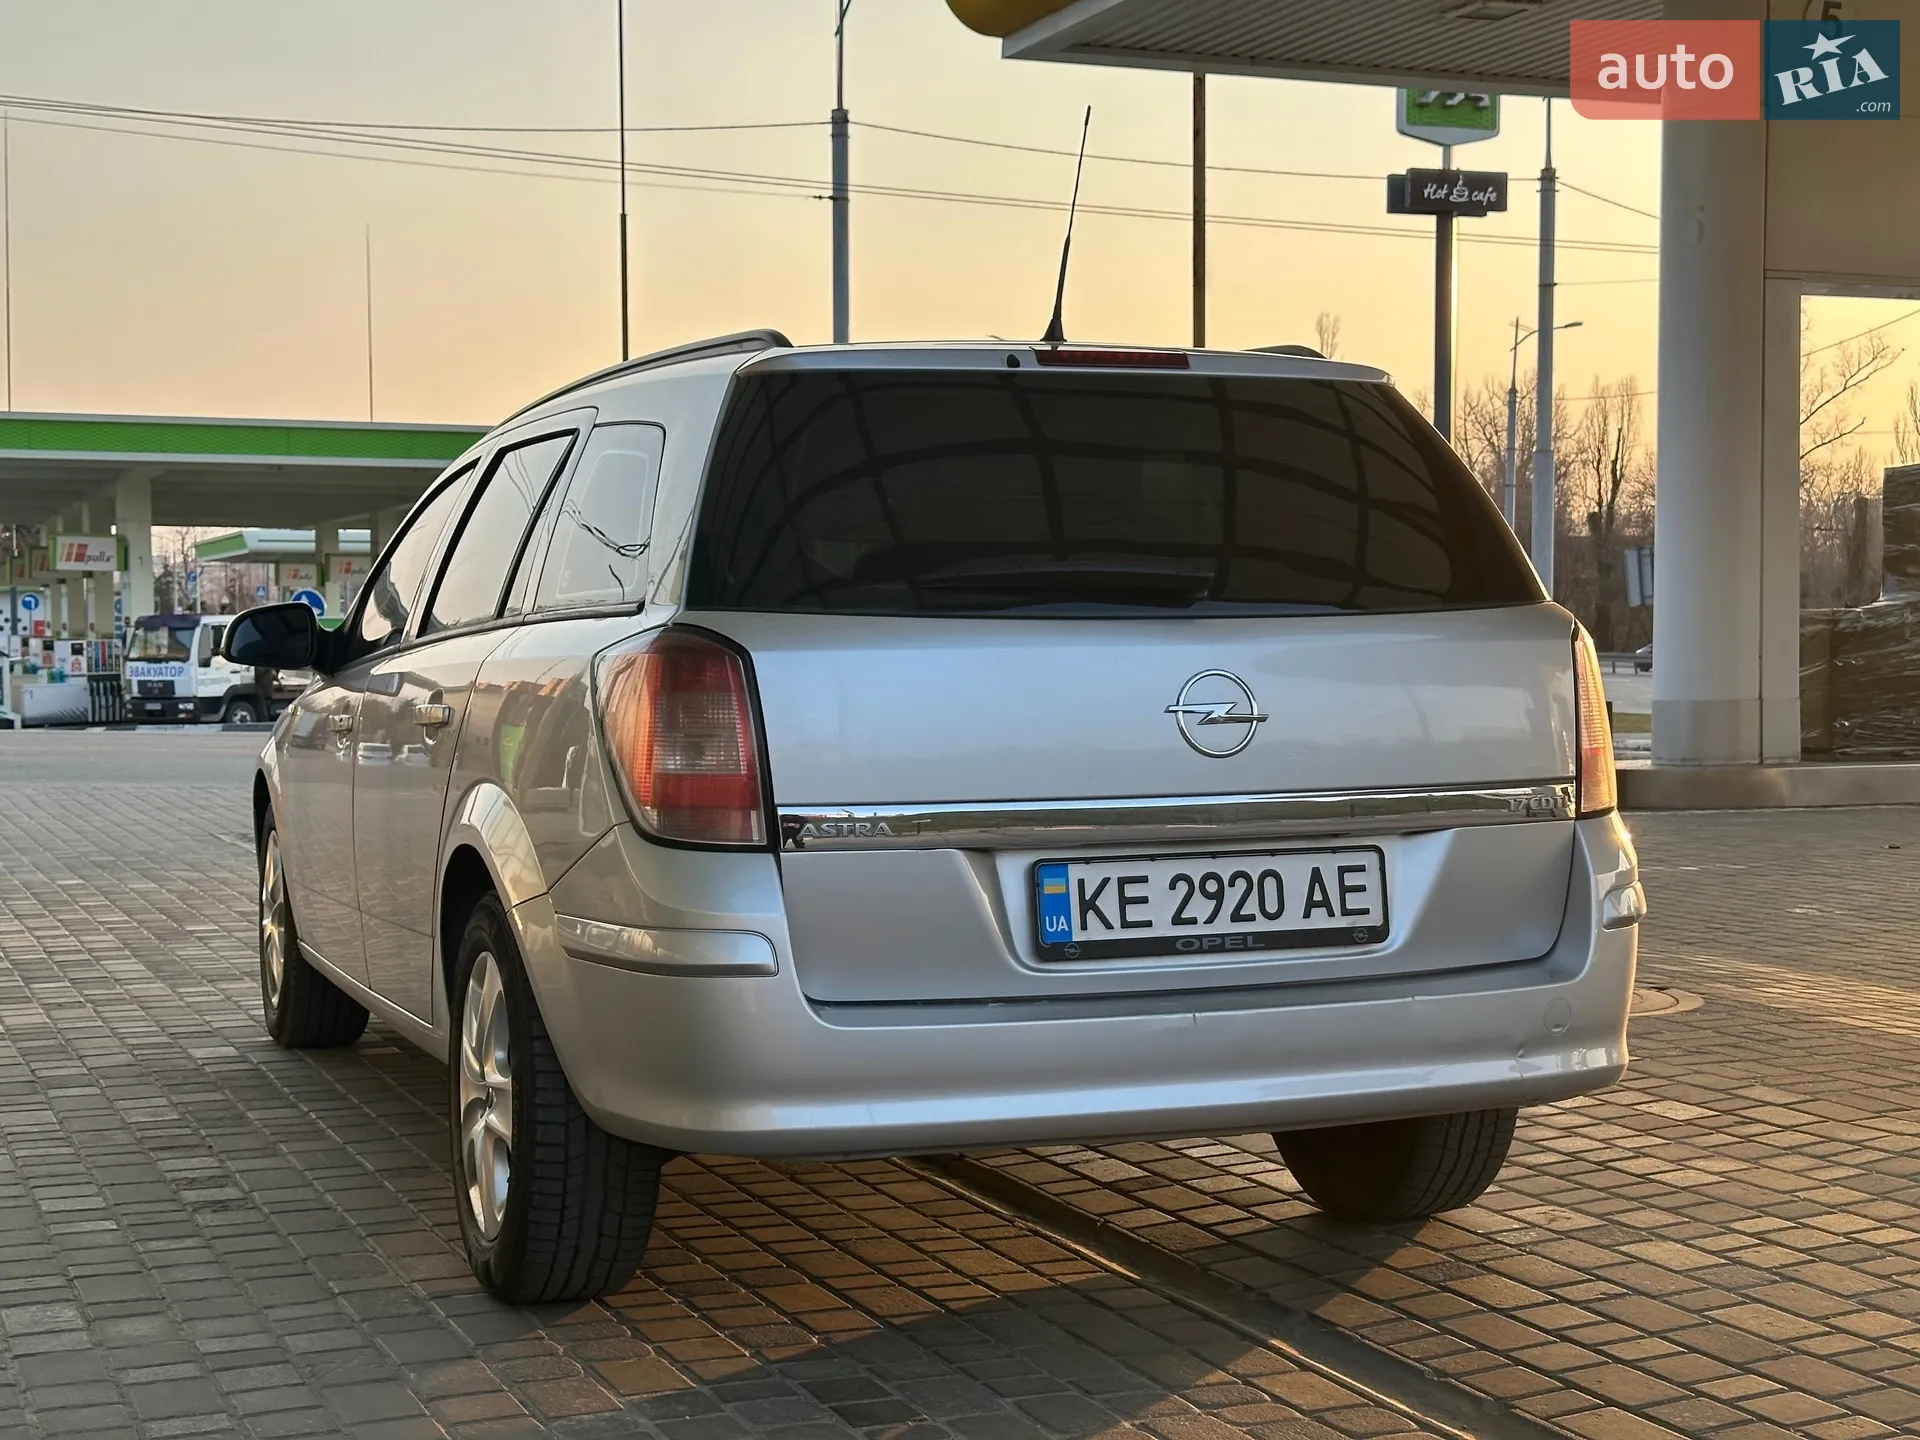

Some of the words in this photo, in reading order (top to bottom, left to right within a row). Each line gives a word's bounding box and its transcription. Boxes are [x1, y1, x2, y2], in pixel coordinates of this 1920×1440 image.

[1423, 183, 1449, 200] Hot
[1471, 186, 1497, 206] cafe
[129, 665, 184, 678] ЭВАКУАТОР
[797, 822, 893, 838] ASTRA
[1077, 875, 1153, 931] KE
[1168, 868, 1285, 926] 2920
[1302, 864, 1371, 919] AE
[1046, 915, 1069, 932] UA
[1175, 935, 1266, 951] OPEL
